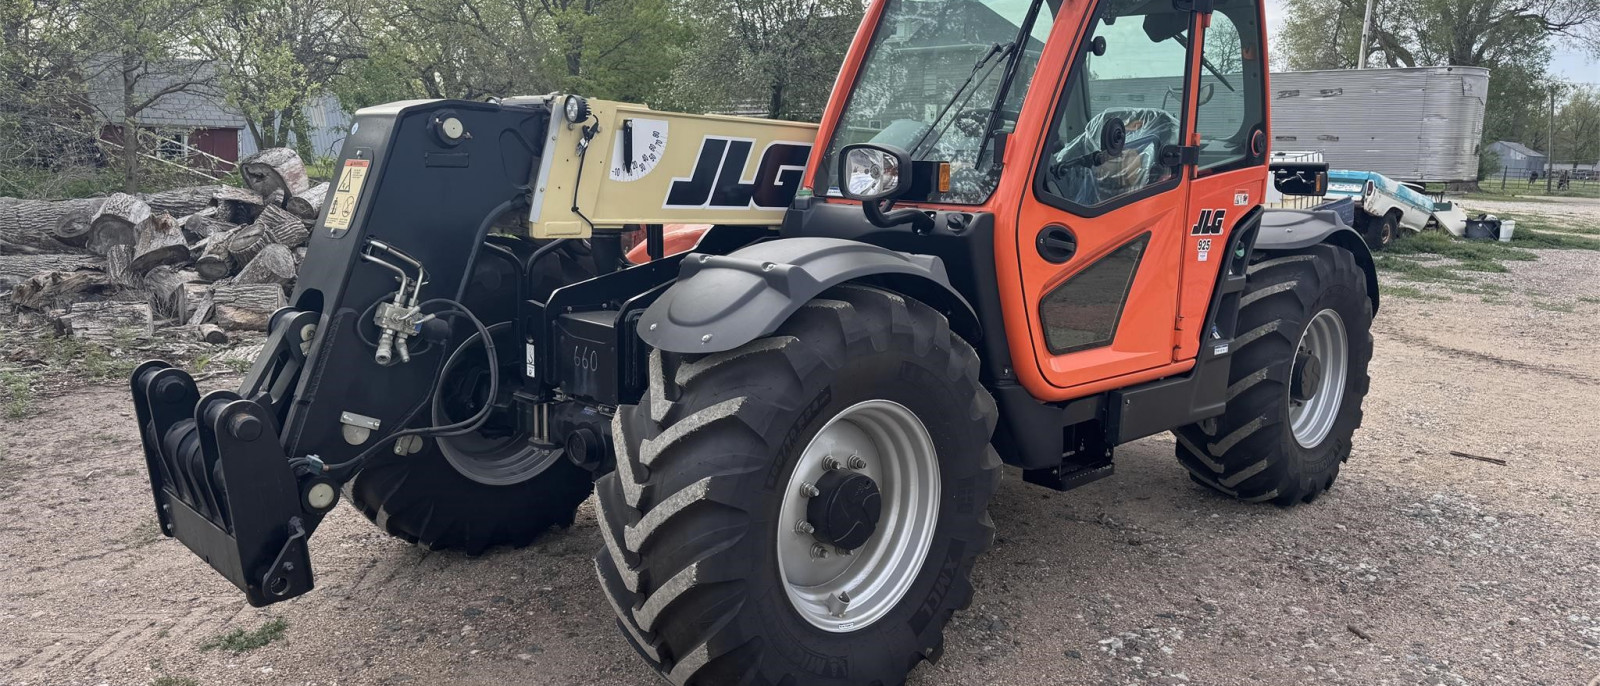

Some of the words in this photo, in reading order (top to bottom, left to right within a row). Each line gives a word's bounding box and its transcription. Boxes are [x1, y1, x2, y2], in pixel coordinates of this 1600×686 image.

[652, 130, 660, 138] 80
[648, 143, 656, 152] 60
[655, 139, 663, 147] 70
[641, 153, 649, 162] 40
[648, 152, 656, 162] 50
[632, 160, 638, 169] 20
[639, 162, 646, 172] 30
[612, 168, 620, 176] -10
[664, 137, 812, 209] JLG
[1191, 209, 1226, 235] JLG
[1198, 240, 1210, 251] 925
[574, 345, 597, 371] 660
[920, 555, 958, 619] XMCL
